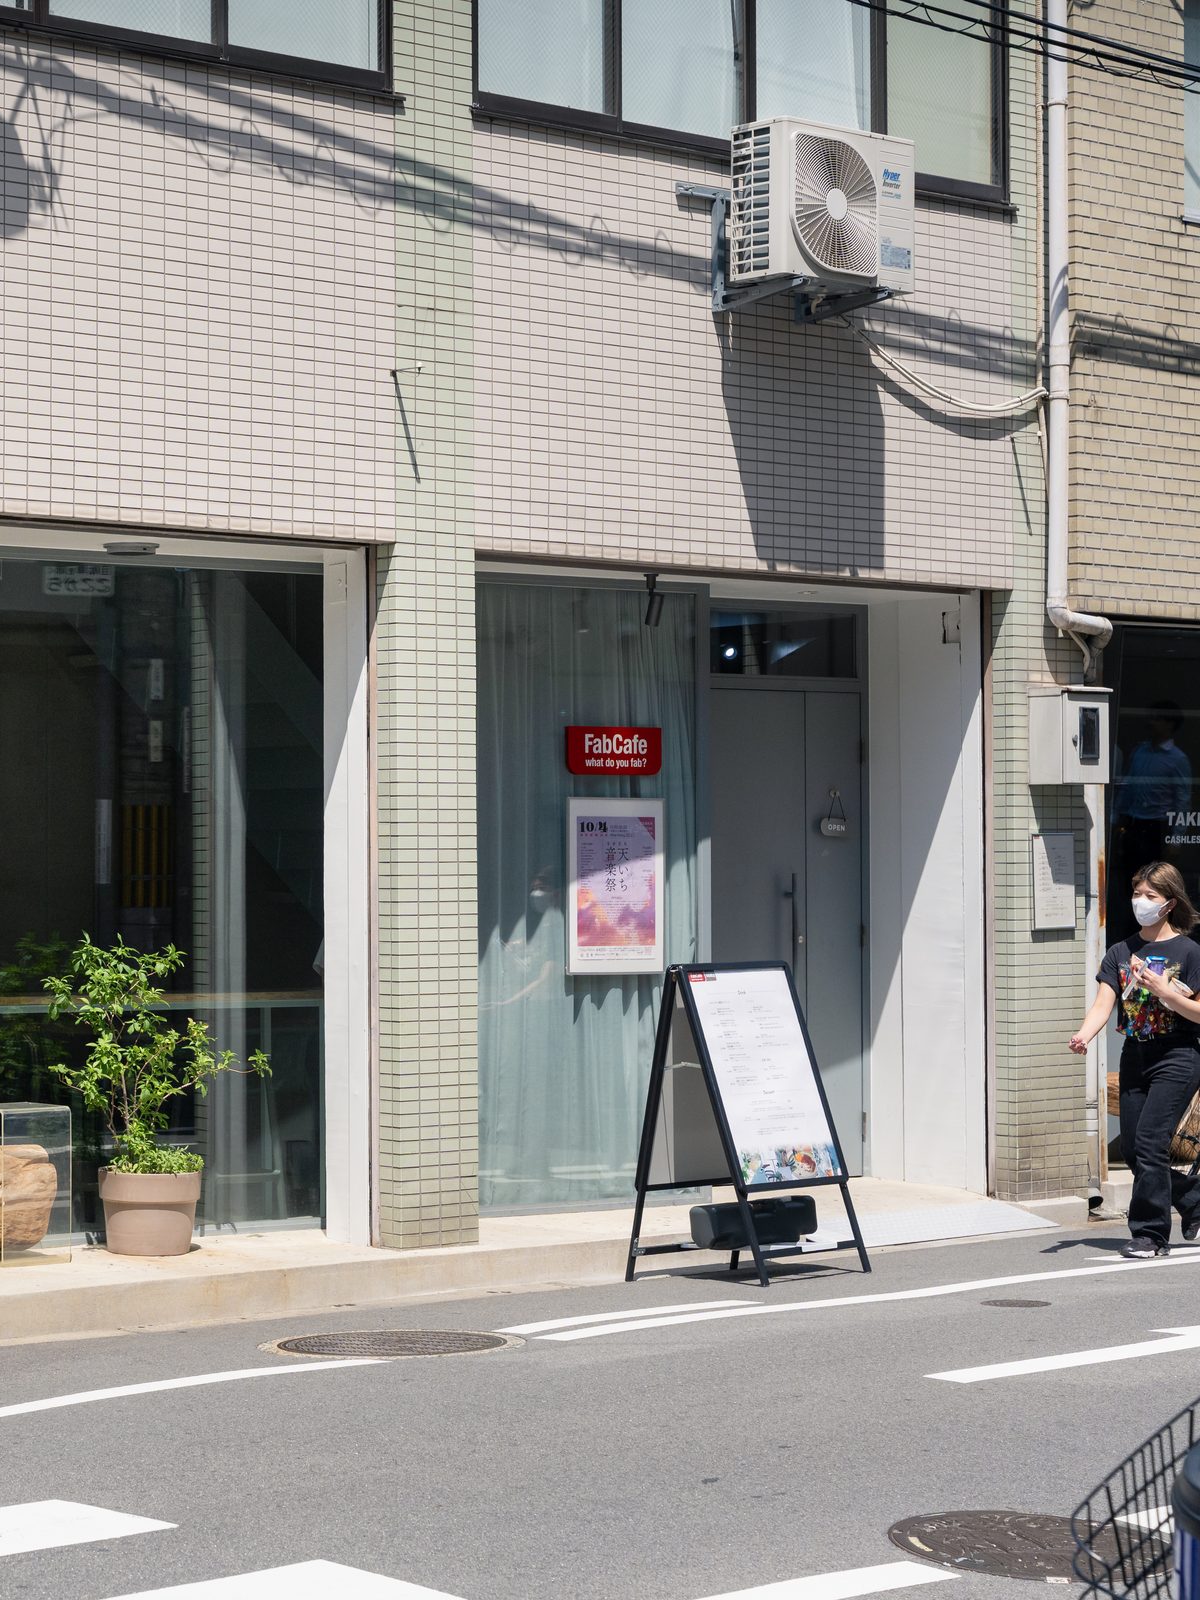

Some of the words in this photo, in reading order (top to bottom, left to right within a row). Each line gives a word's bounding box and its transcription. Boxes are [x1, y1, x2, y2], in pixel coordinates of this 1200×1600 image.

[882, 168, 901, 181] Hyper
[584, 733, 648, 755] FabCafe
[585, 758, 604, 767] what
[605, 758, 613, 767] do
[614, 760, 629, 769] you
[630, 758, 647, 768] fab?
[827, 823, 846, 832] OPEN
[605, 847, 616, 892] 音楽祭
[617, 847, 629, 892] 天いち
